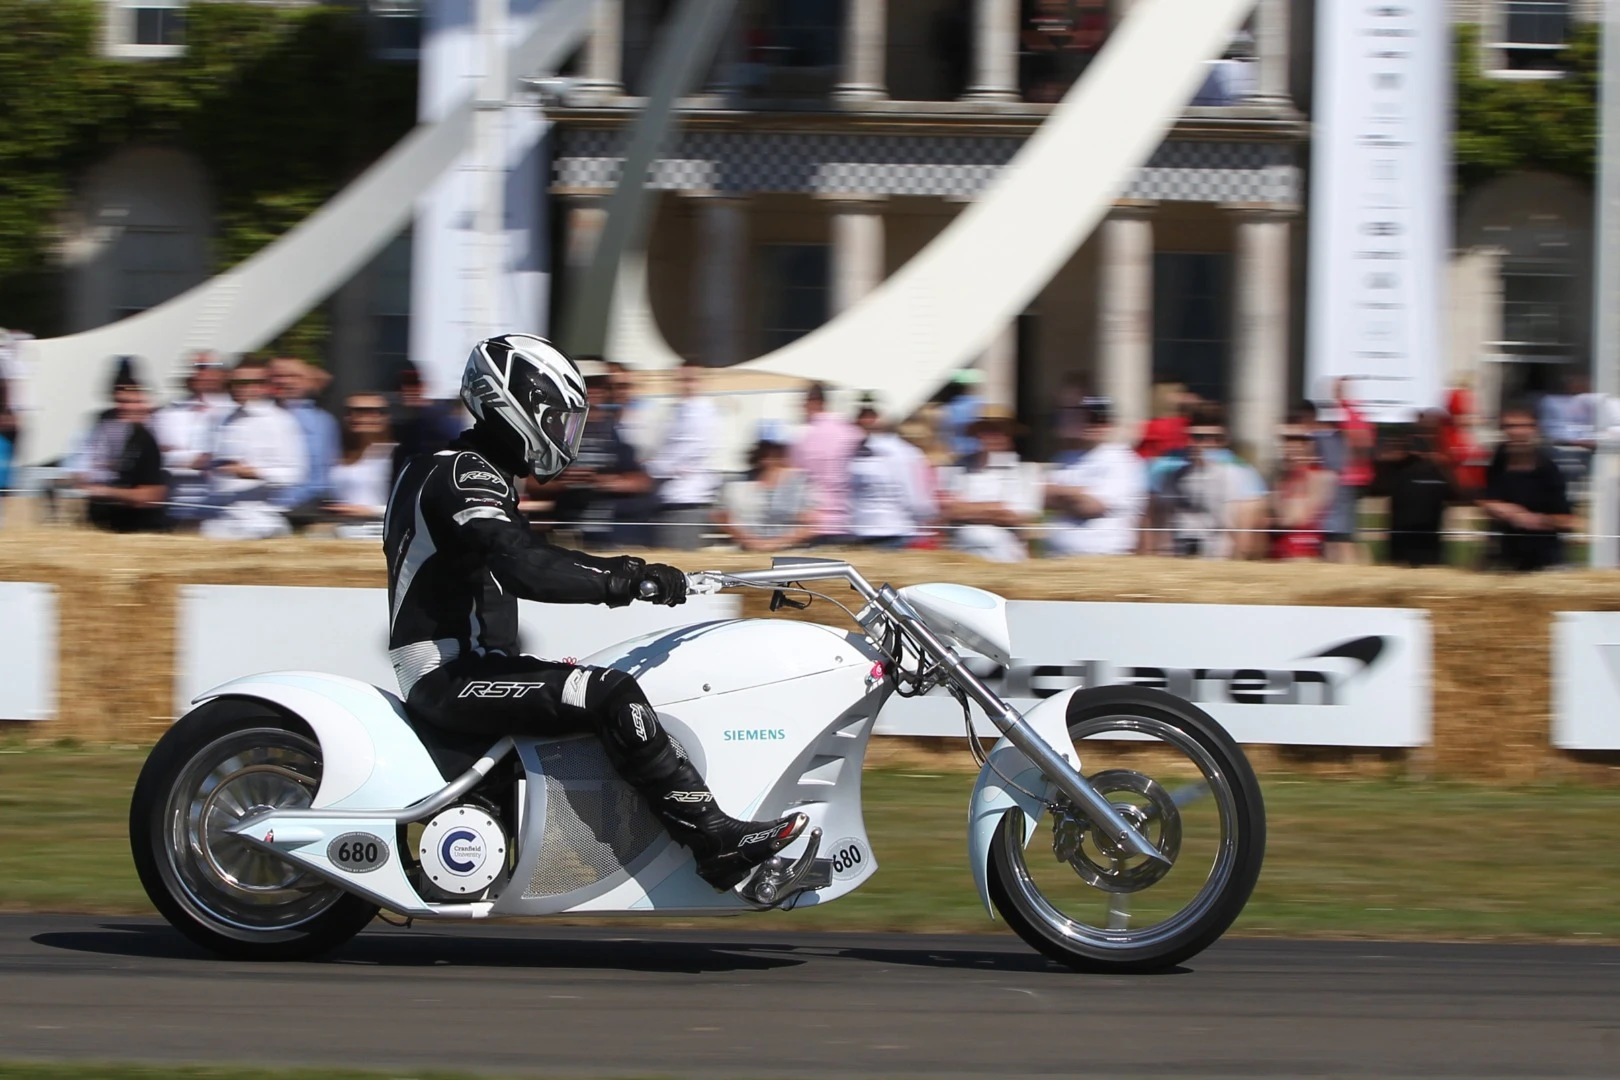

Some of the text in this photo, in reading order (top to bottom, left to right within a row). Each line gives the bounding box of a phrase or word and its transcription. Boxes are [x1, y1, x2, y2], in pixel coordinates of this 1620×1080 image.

[459, 471, 506, 486] RST
[457, 681, 546, 698] RST
[629, 703, 648, 741] RST
[723, 729, 785, 741] SIEMENS
[663, 791, 714, 803] RST
[738, 822, 789, 847] RST
[338, 842, 378, 863] 680
[833, 844, 861, 873] 680
